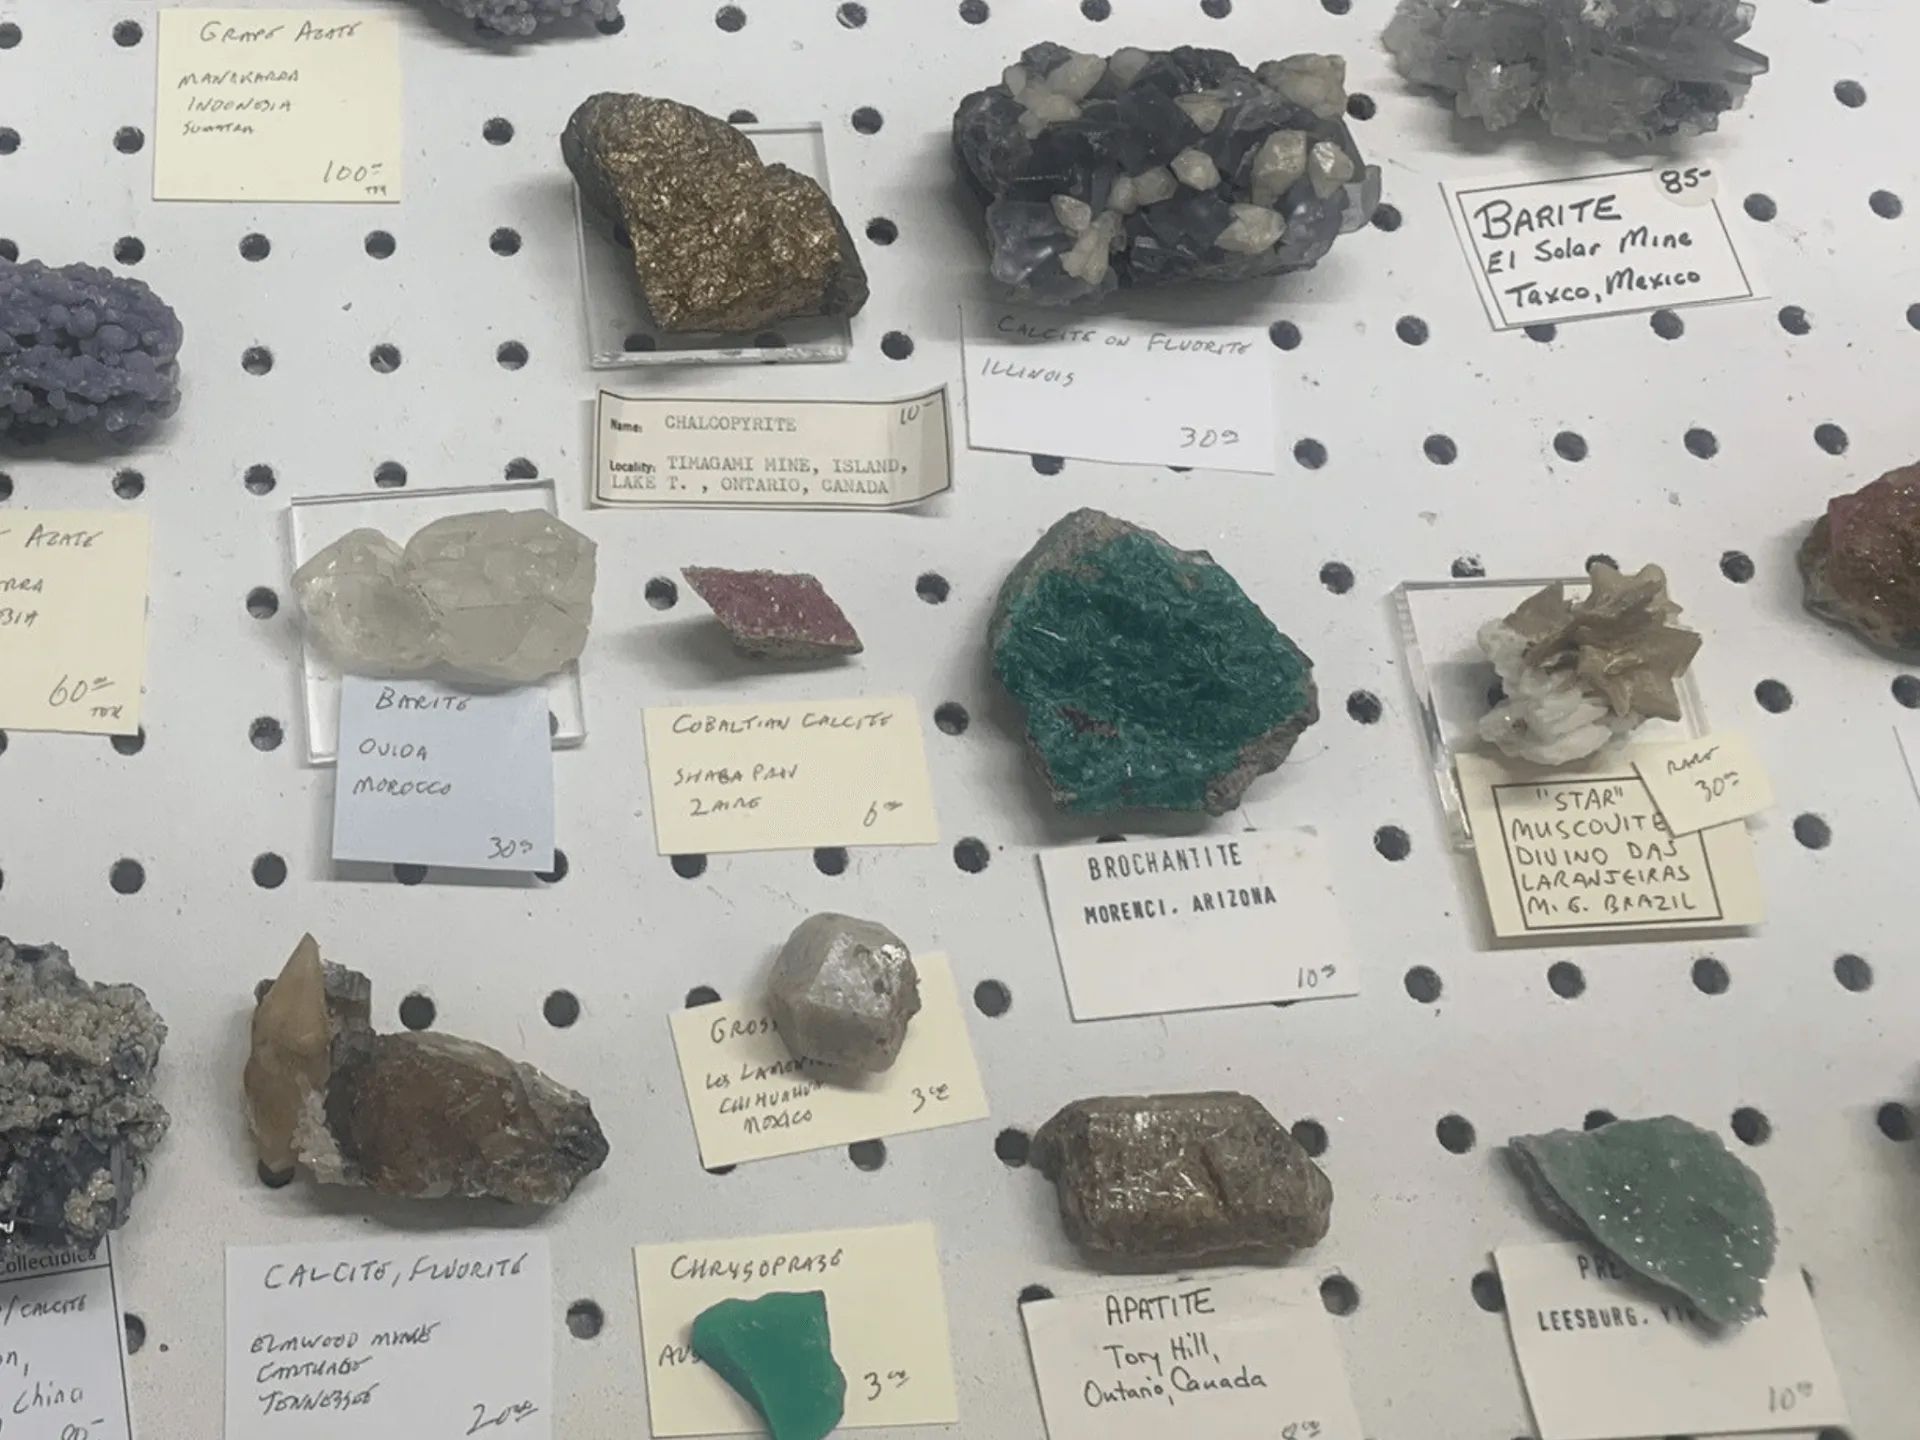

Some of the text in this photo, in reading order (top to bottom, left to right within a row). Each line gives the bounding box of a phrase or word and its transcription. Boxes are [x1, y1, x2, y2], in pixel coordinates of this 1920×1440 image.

[1473, 194, 1622, 240] BARITE
[1487, 226, 1693, 275] El Solar Mine
[1505, 267, 1701, 308] Taxco, Mexico
[998, 315, 1253, 356] CALCITE ON FLUORITE
[981, 358, 1075, 388] ILLINOIS
[610, 415, 797, 434] Name: CHALCOPYRITE
[609, 455, 908, 475] Locality: TIMAGAMI MINE, ISLAND,
[611, 475, 657, 491] LAKE
[721, 476, 810, 496] ONTARIO,
[821, 477, 890, 495] CANADA
[375, 686, 472, 711] BARITE
[672, 712, 893, 734] COBALTIAN CALCITE
[353, 776, 451, 795] MOROCCO
[1536, 786, 1624, 812] "STAR"
[1087, 842, 1243, 881] BROCHANTITE
[1515, 839, 1678, 867] DIVINO DAS
[1521, 865, 1691, 892] LARANJEIRAS
[1192, 885, 1277, 913] ARIZONA
[1604, 892, 1697, 915] BRAZIL
[408, 1252, 529, 1282] FLUORITE
[1106, 1287, 1216, 1326] APATITE
[1103, 1331, 1221, 1377] Tory Hill,
[1170, 1365, 1268, 1393] Canada
[13, 1381, 84, 1415] China
